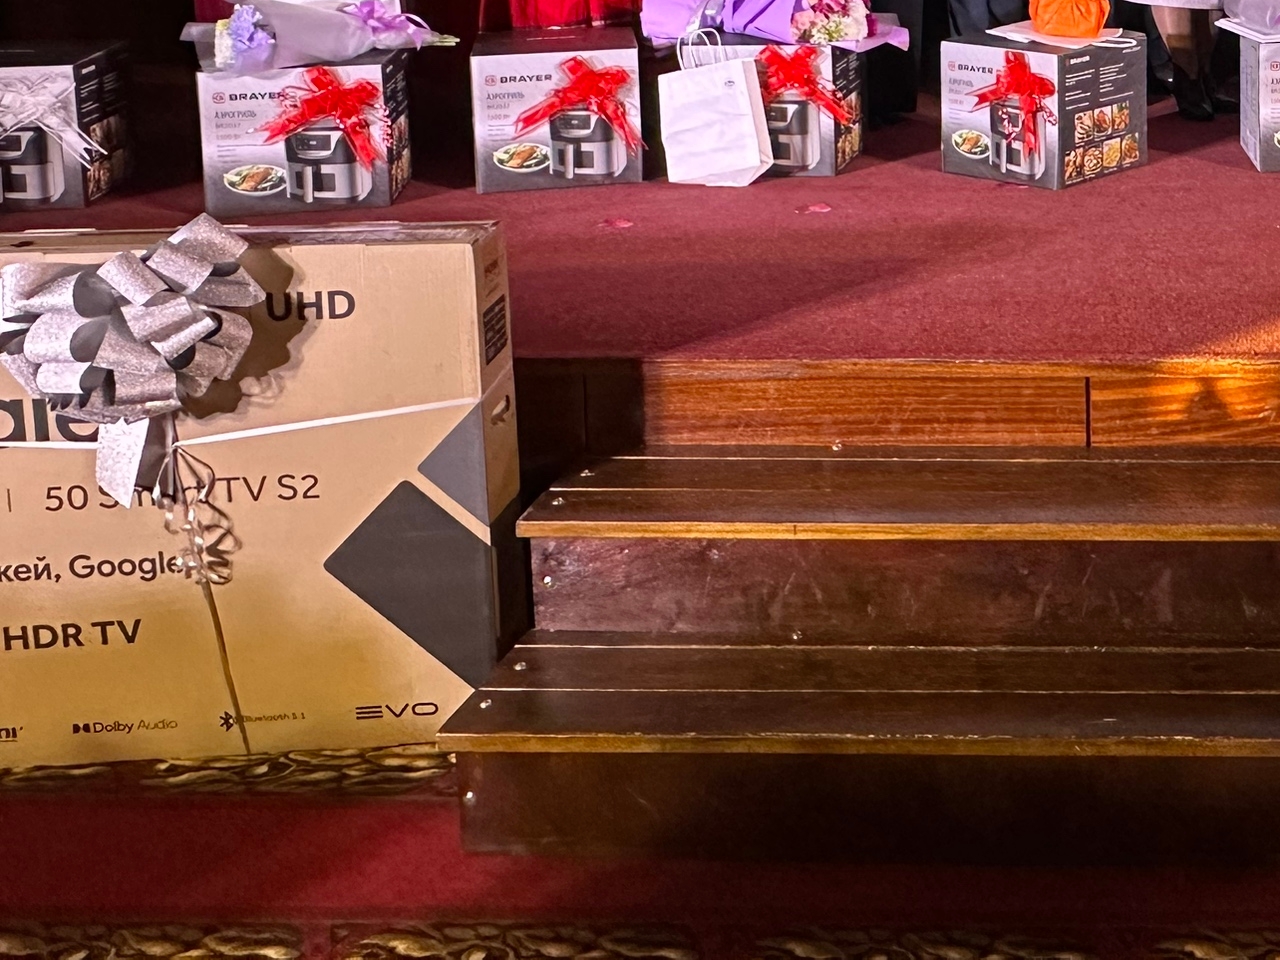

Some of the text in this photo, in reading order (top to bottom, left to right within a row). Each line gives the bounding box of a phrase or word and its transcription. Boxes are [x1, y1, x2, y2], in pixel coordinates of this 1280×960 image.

[500, 74, 553, 84] BRAYER
[957, 63, 994, 76] BRAYER
[264, 289, 356, 322] UHD
[45, 484, 89, 512] 50
[214, 475, 267, 504] TV
[277, 474, 321, 500] S2
[0, 551, 184, 583] кей, Google
[2, 618, 142, 651] HDR TV
[93, 721, 134, 735] Dolby
